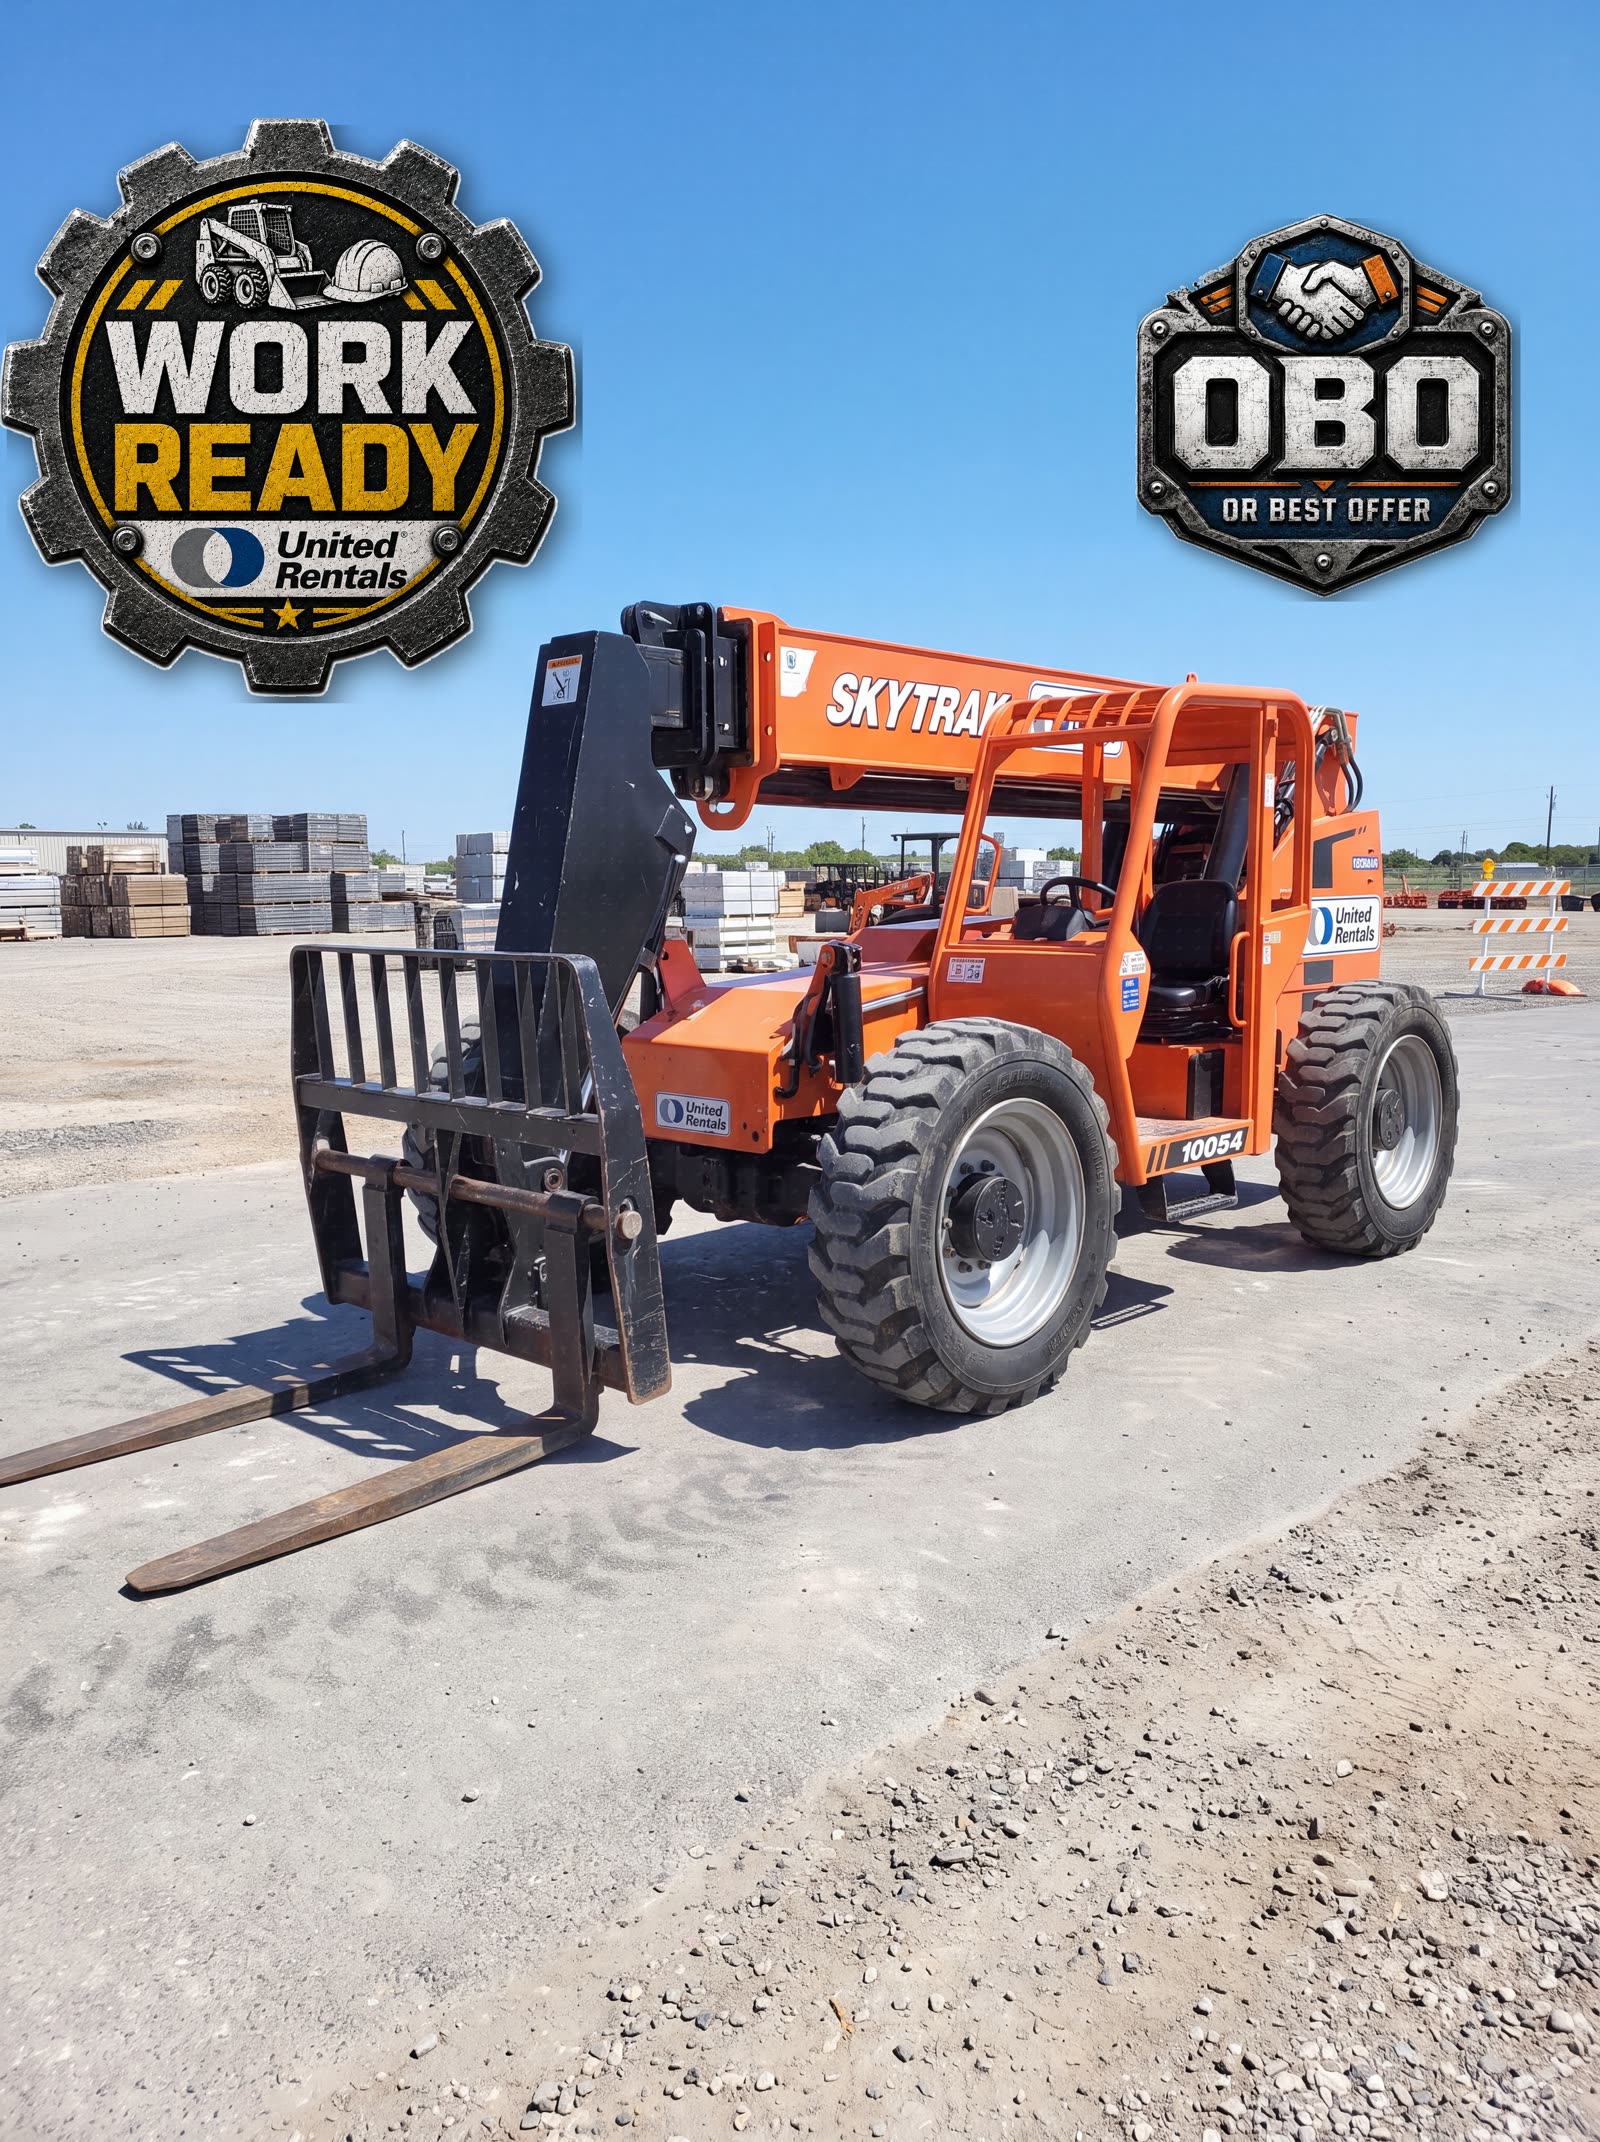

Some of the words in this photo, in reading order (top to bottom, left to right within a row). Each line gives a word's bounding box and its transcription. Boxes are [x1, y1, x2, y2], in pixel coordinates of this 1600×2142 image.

[1336, 906, 1372, 924] United
[1335, 925, 1375, 944] Rentals
[686, 1101, 723, 1117] United
[686, 1114, 726, 1131] Rentals
[1182, 1131, 1243, 1163] 10054
